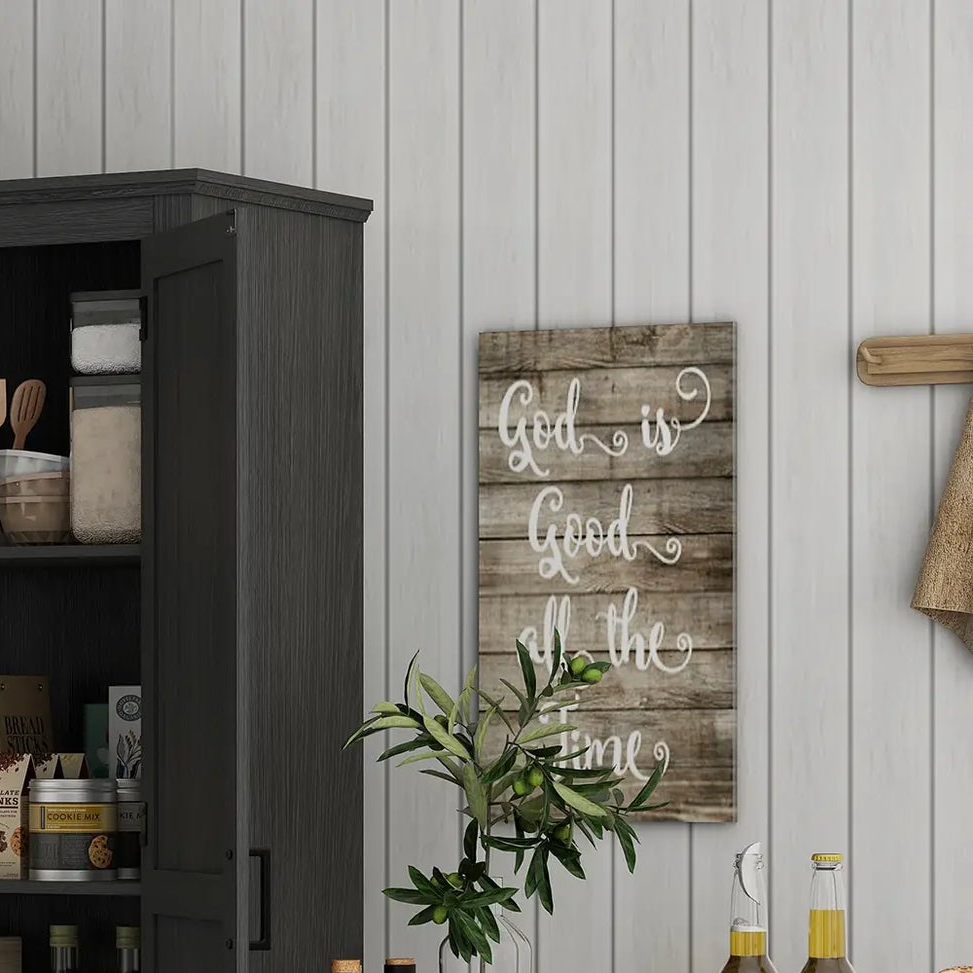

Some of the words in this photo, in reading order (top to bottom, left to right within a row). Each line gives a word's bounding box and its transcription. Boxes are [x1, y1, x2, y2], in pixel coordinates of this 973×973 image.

[498, 377, 629, 477] God
[640, 366, 711, 456] is
[528, 483, 682, 584] Good
[595, 586, 693, 674] the
[4, 715, 45, 736] BREAD
[7, 735, 48, 754] STICKS
[46, 812, 82, 822] COOKIE
[83, 812, 101, 822] MIX
